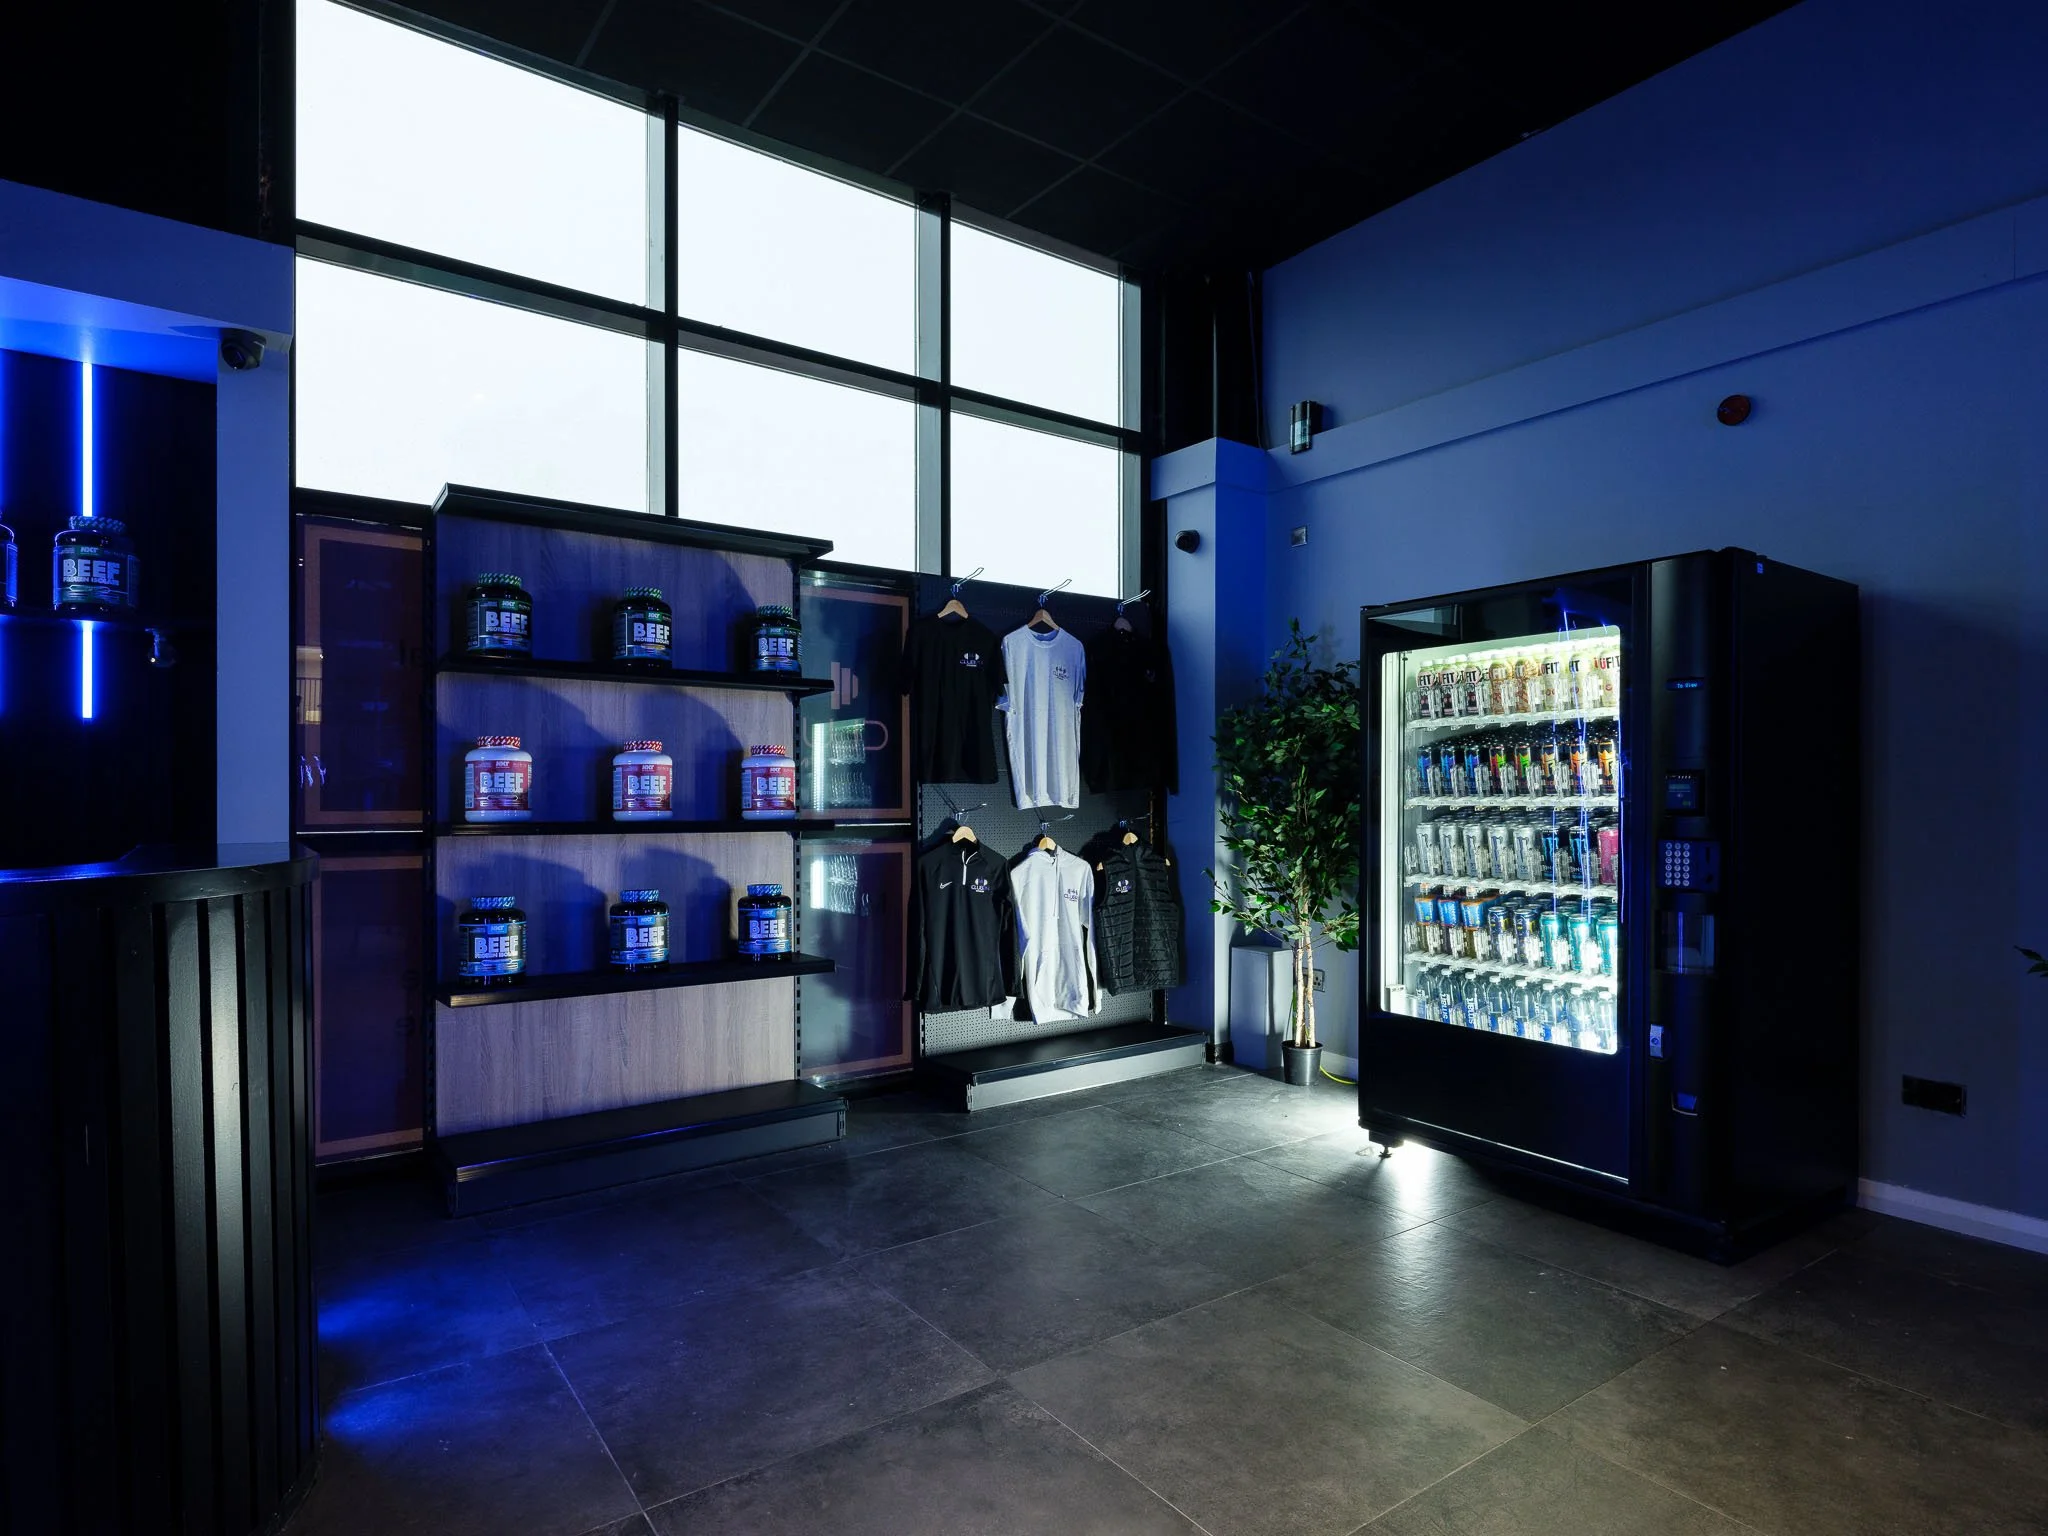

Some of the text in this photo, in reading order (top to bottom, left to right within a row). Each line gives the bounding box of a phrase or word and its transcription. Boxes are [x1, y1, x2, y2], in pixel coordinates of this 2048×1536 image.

[63, 558, 121, 580] BEEF
[486, 610, 528, 629] BEEF
[633, 622, 670, 640] BEEF
[758, 637, 794, 652] BEEF
[480, 772, 524, 788] BEEF
[628, 775, 666, 790] BEEF
[757, 776, 791, 791] BEEF
[626, 926, 665, 945] BEEF
[750, 919, 786, 935] BEEF
[475, 935, 519, 954] BEEF
[1466, 997, 1475, 1025] smart
